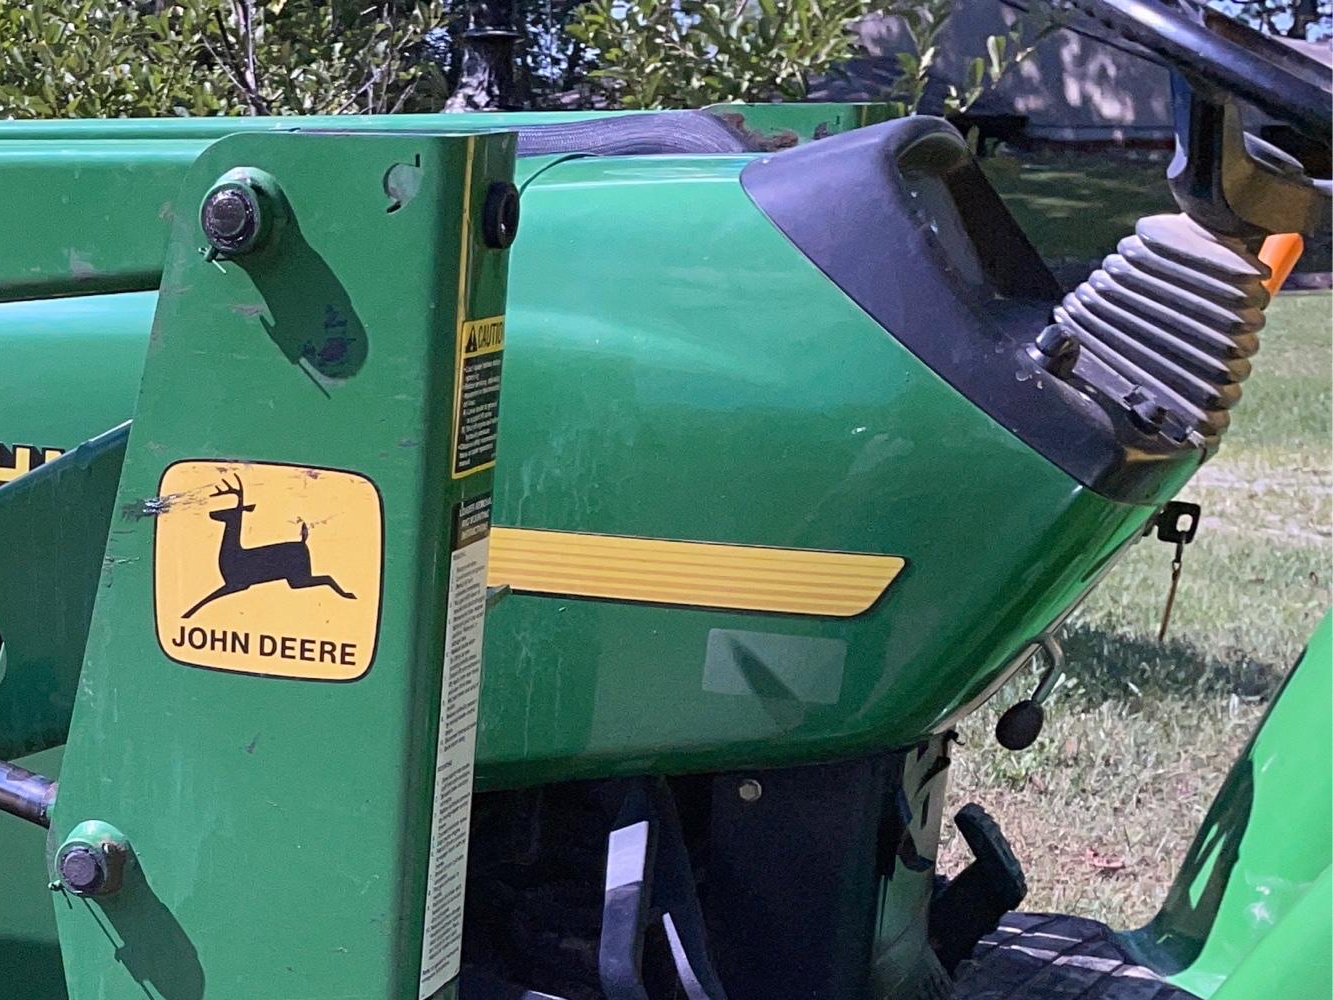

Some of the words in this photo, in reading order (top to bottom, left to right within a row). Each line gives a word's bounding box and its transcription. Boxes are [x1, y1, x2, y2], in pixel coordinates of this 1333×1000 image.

[478, 320, 504, 349] CAUTIO
[172, 626, 250, 654] JOHN
[259, 635, 357, 666] DEERE
